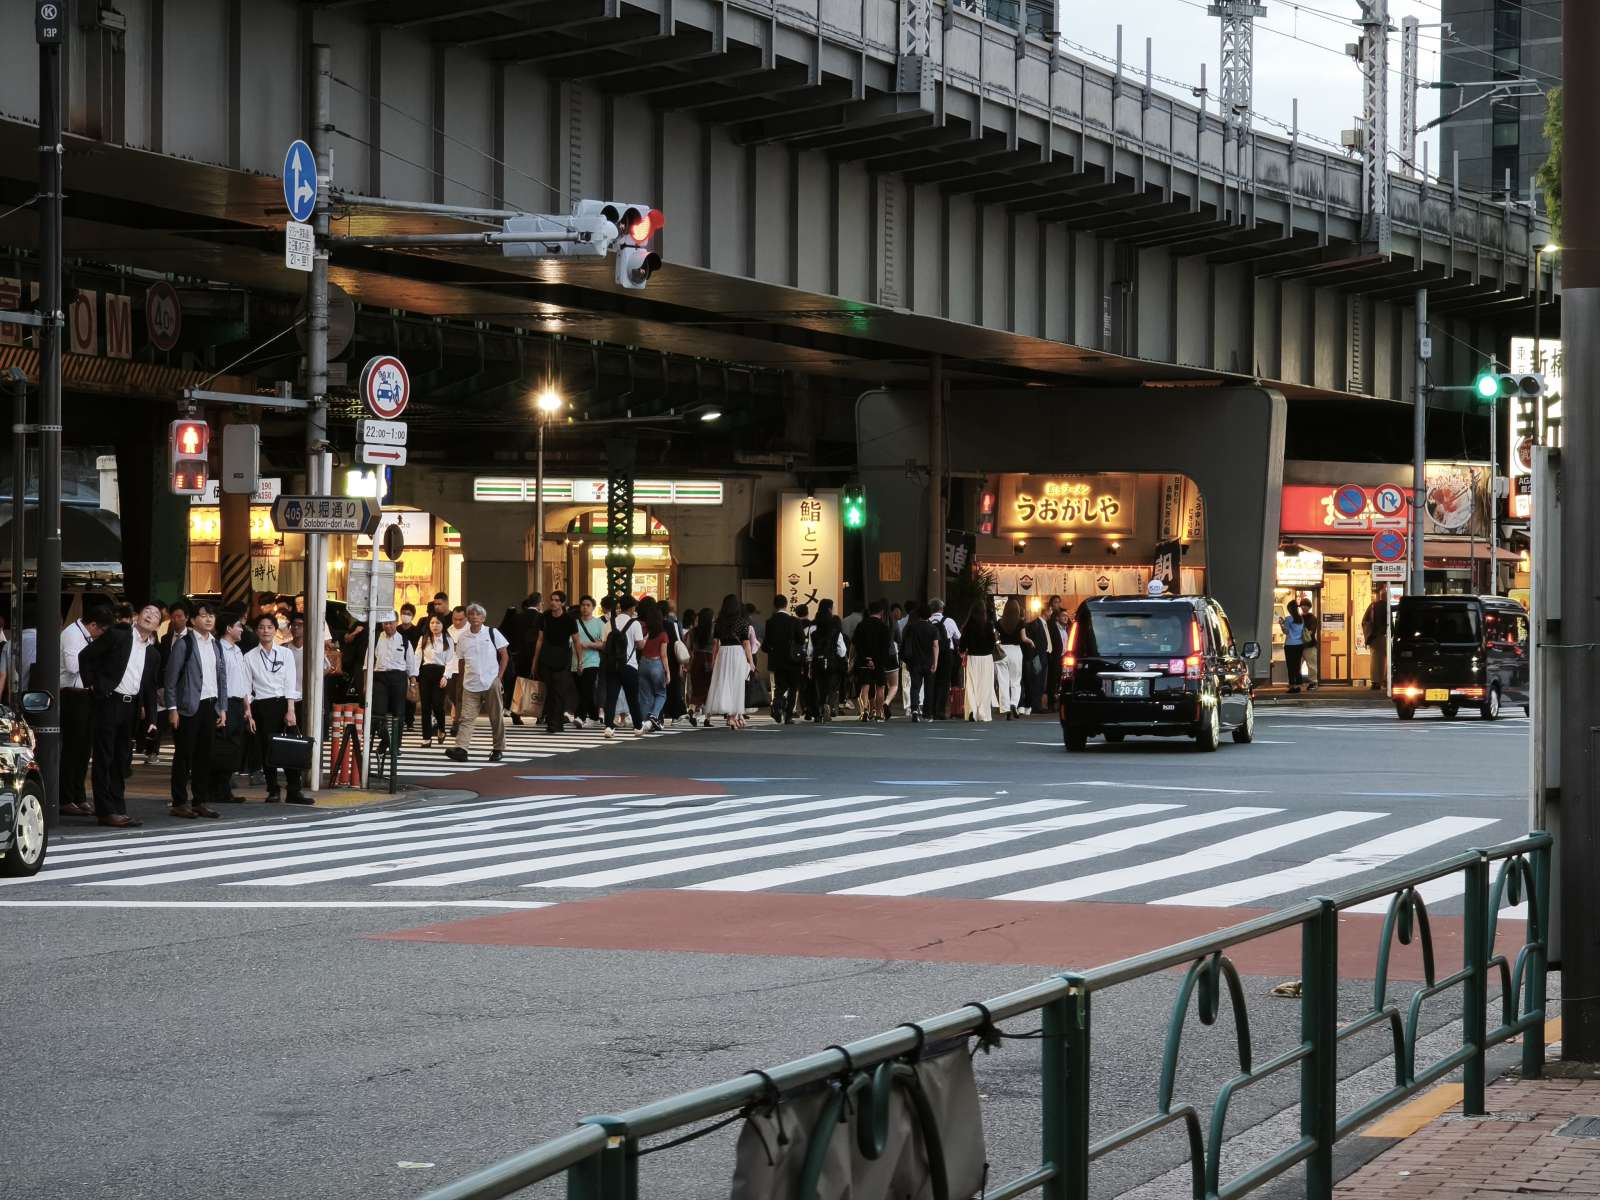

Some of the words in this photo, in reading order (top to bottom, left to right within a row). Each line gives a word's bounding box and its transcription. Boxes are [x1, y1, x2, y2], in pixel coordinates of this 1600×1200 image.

[286, 507, 301, 520] 405
[304, 501, 356, 519] 外堀通り
[1016, 494, 1120, 523] うおがしや
[303, 519, 342, 528] Sotobori-dori
